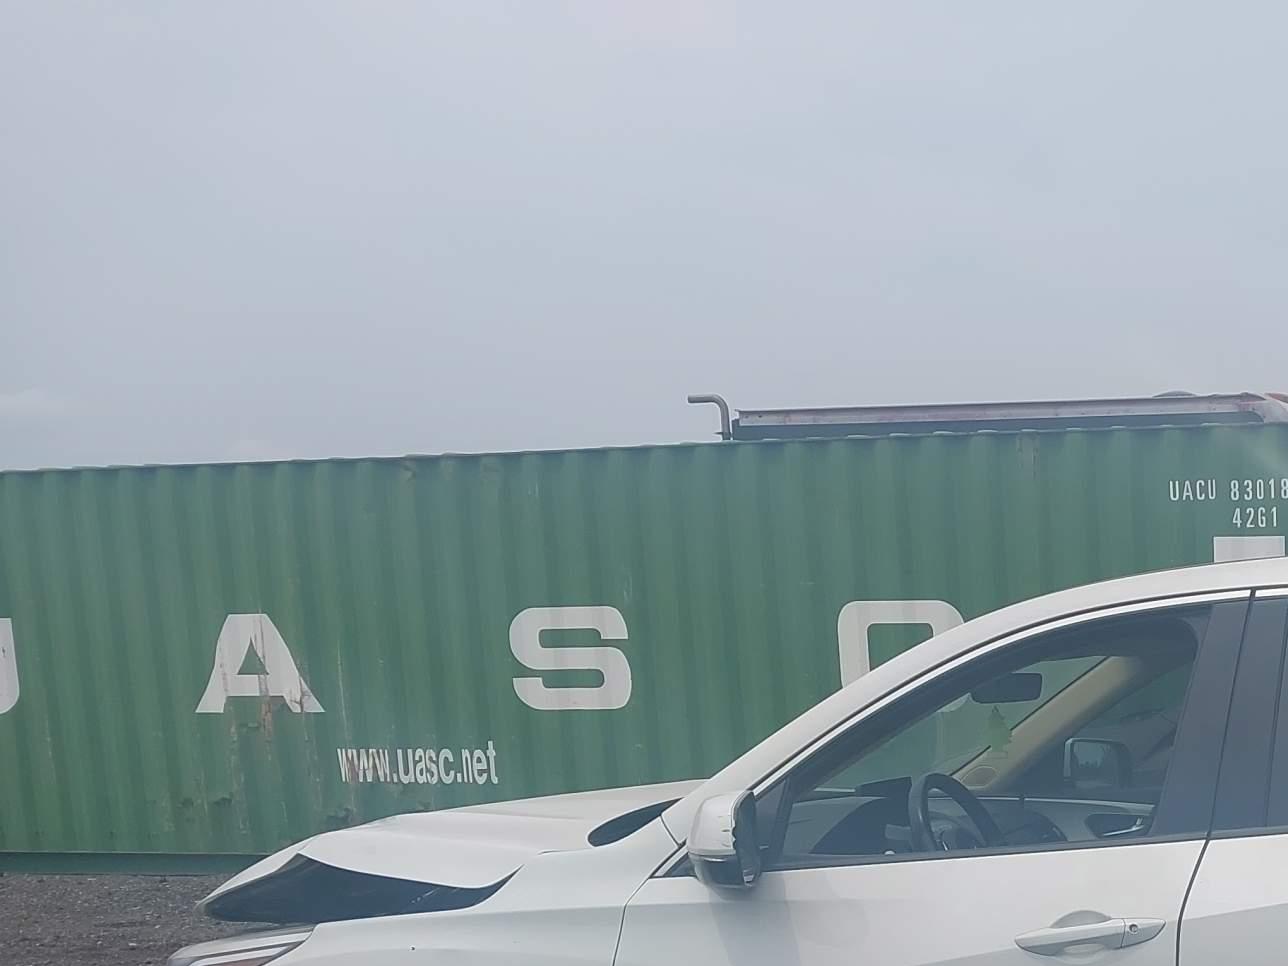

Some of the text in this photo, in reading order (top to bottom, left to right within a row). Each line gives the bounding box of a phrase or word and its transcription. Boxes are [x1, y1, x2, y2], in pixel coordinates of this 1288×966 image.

[1168, 479, 1217, 501] UACU
[1232, 506, 1279, 528] 42G1
[337, 740, 499, 785] www.uasc.net
